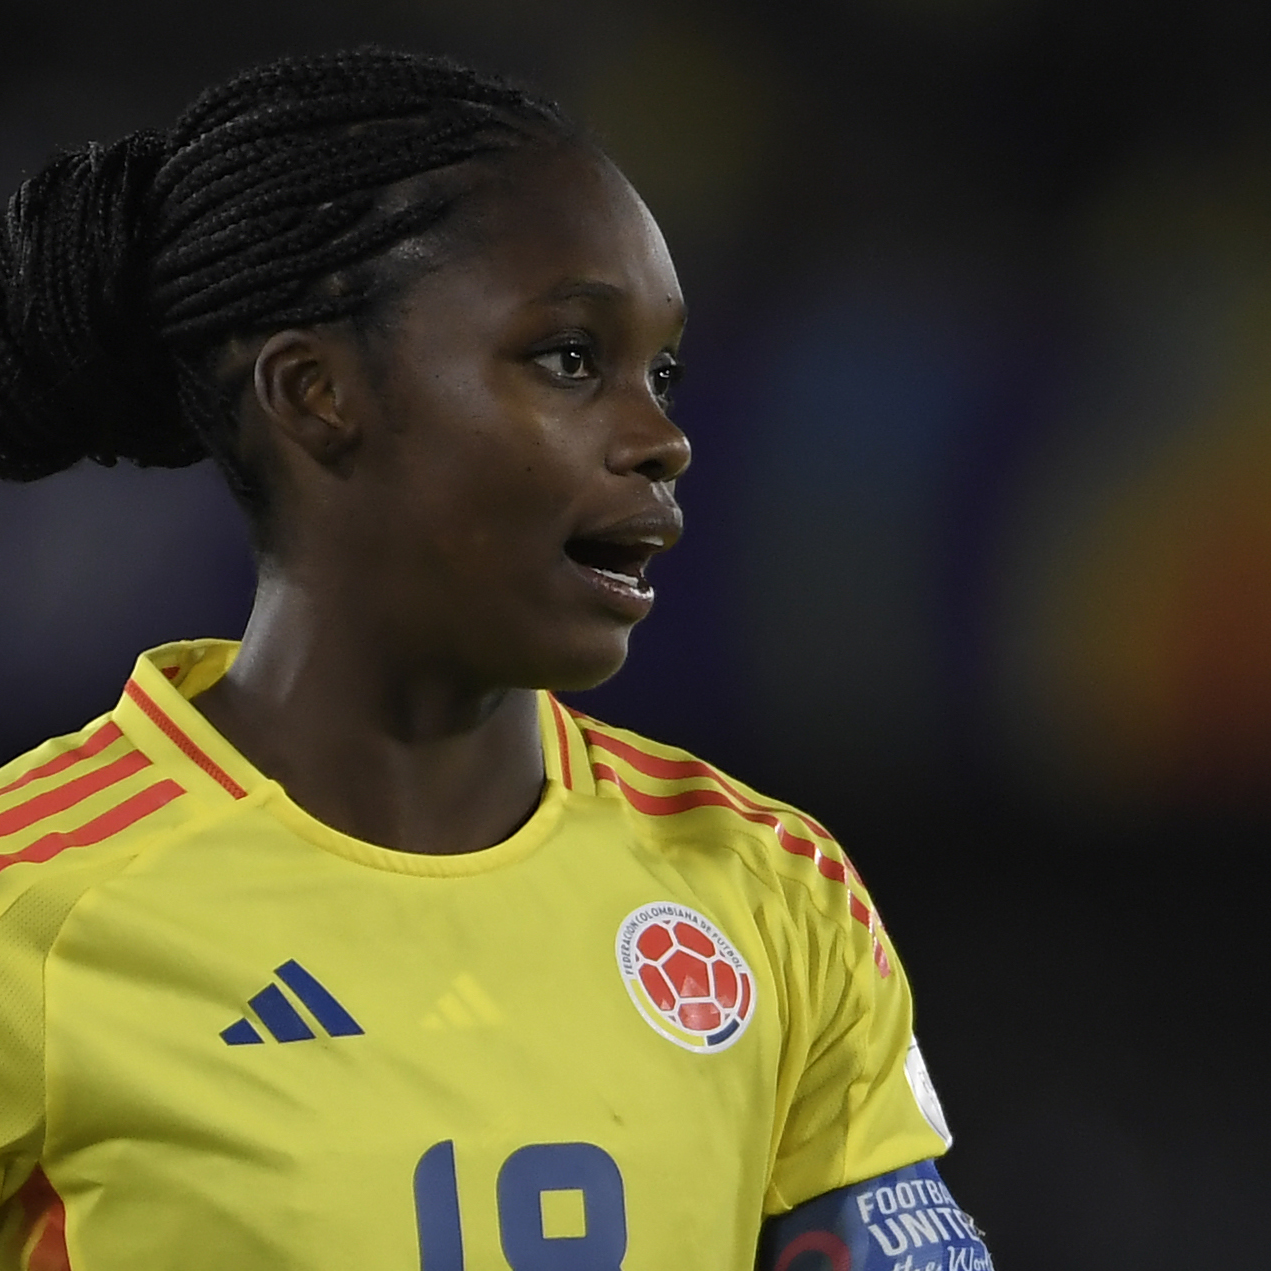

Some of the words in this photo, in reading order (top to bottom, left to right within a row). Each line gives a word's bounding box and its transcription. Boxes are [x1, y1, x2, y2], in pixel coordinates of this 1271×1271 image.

[634, 906, 698, 924] COLOMBIANA
[856, 1179, 959, 1224] FOOTBA
[868, 1207, 981, 1257] UNITE
